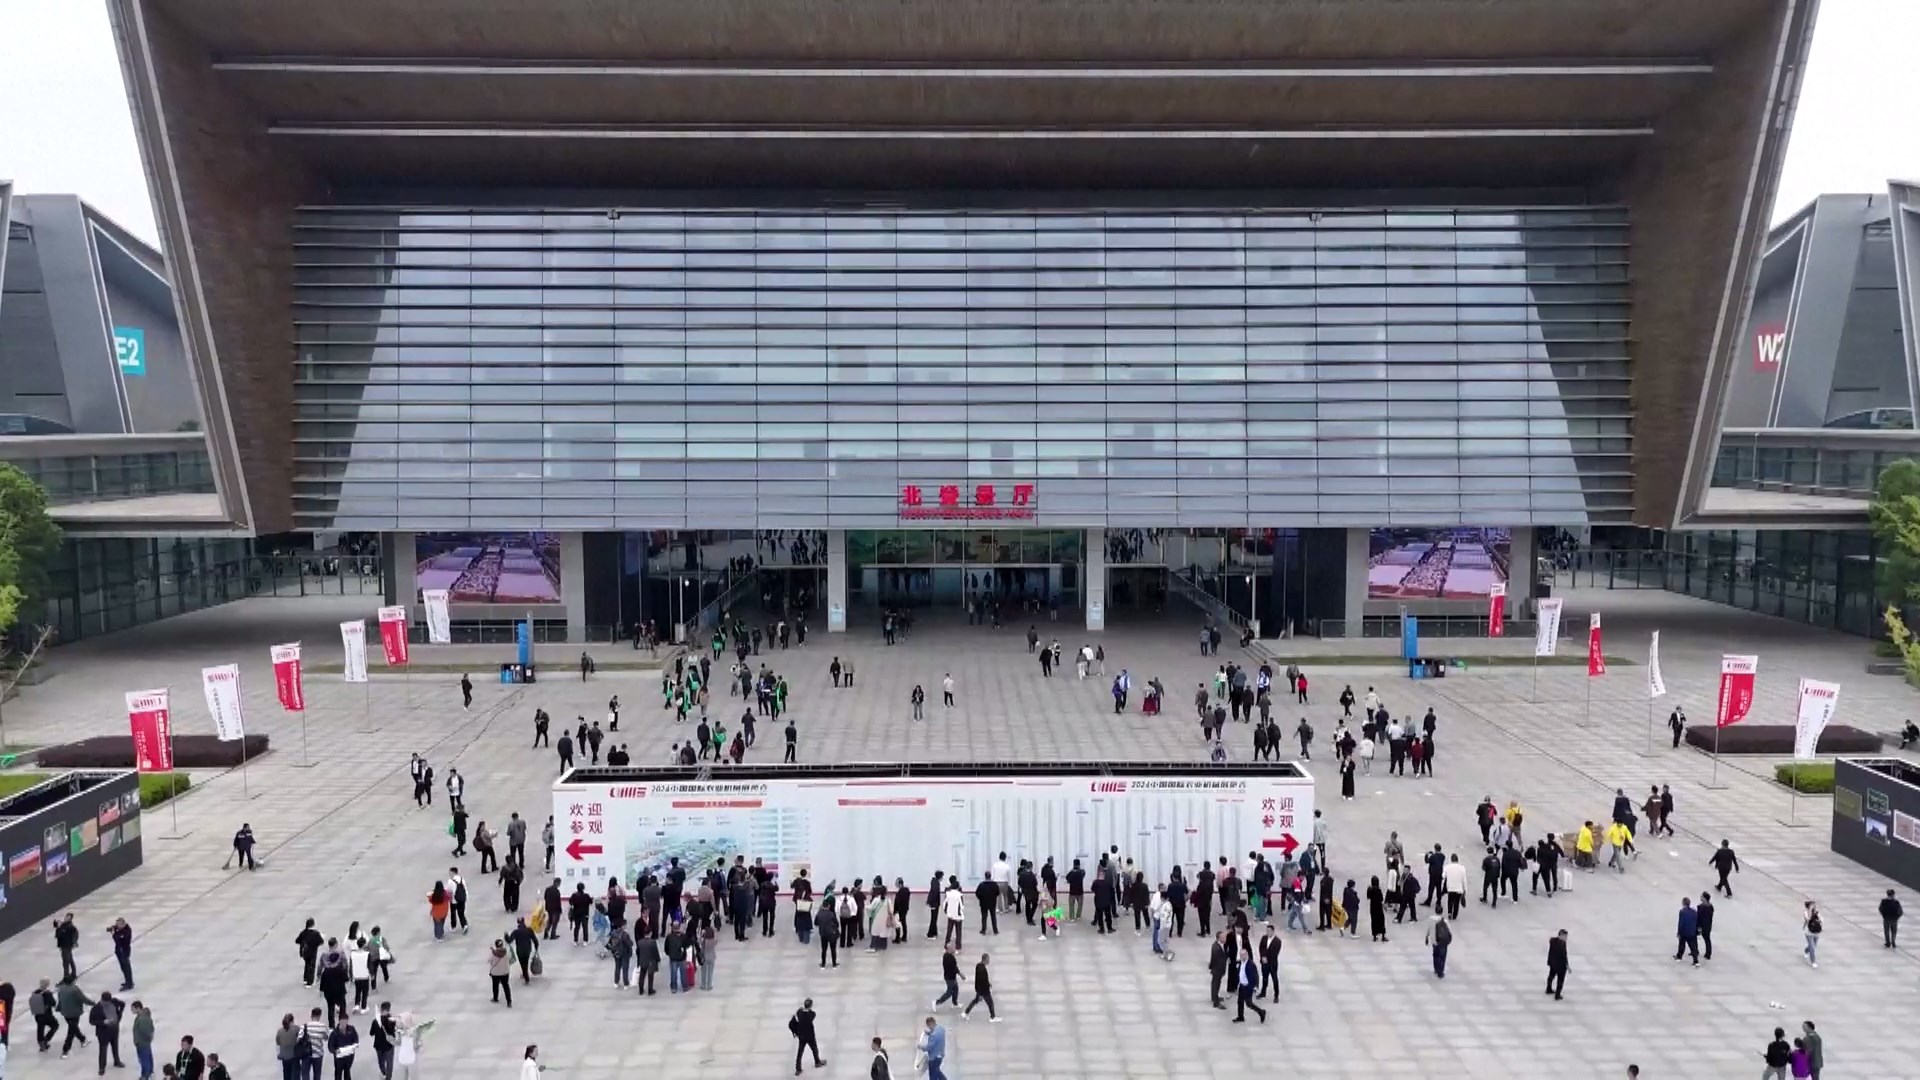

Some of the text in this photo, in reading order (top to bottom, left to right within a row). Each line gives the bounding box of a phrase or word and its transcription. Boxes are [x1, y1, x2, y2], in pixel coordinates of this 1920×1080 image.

[114, 337, 140, 366] E2
[569, 803, 602, 816] 欢迎
[1262, 797, 1294, 812] 欢迎
[570, 820, 603, 834] 参观
[1262, 815, 1294, 828] 参观
